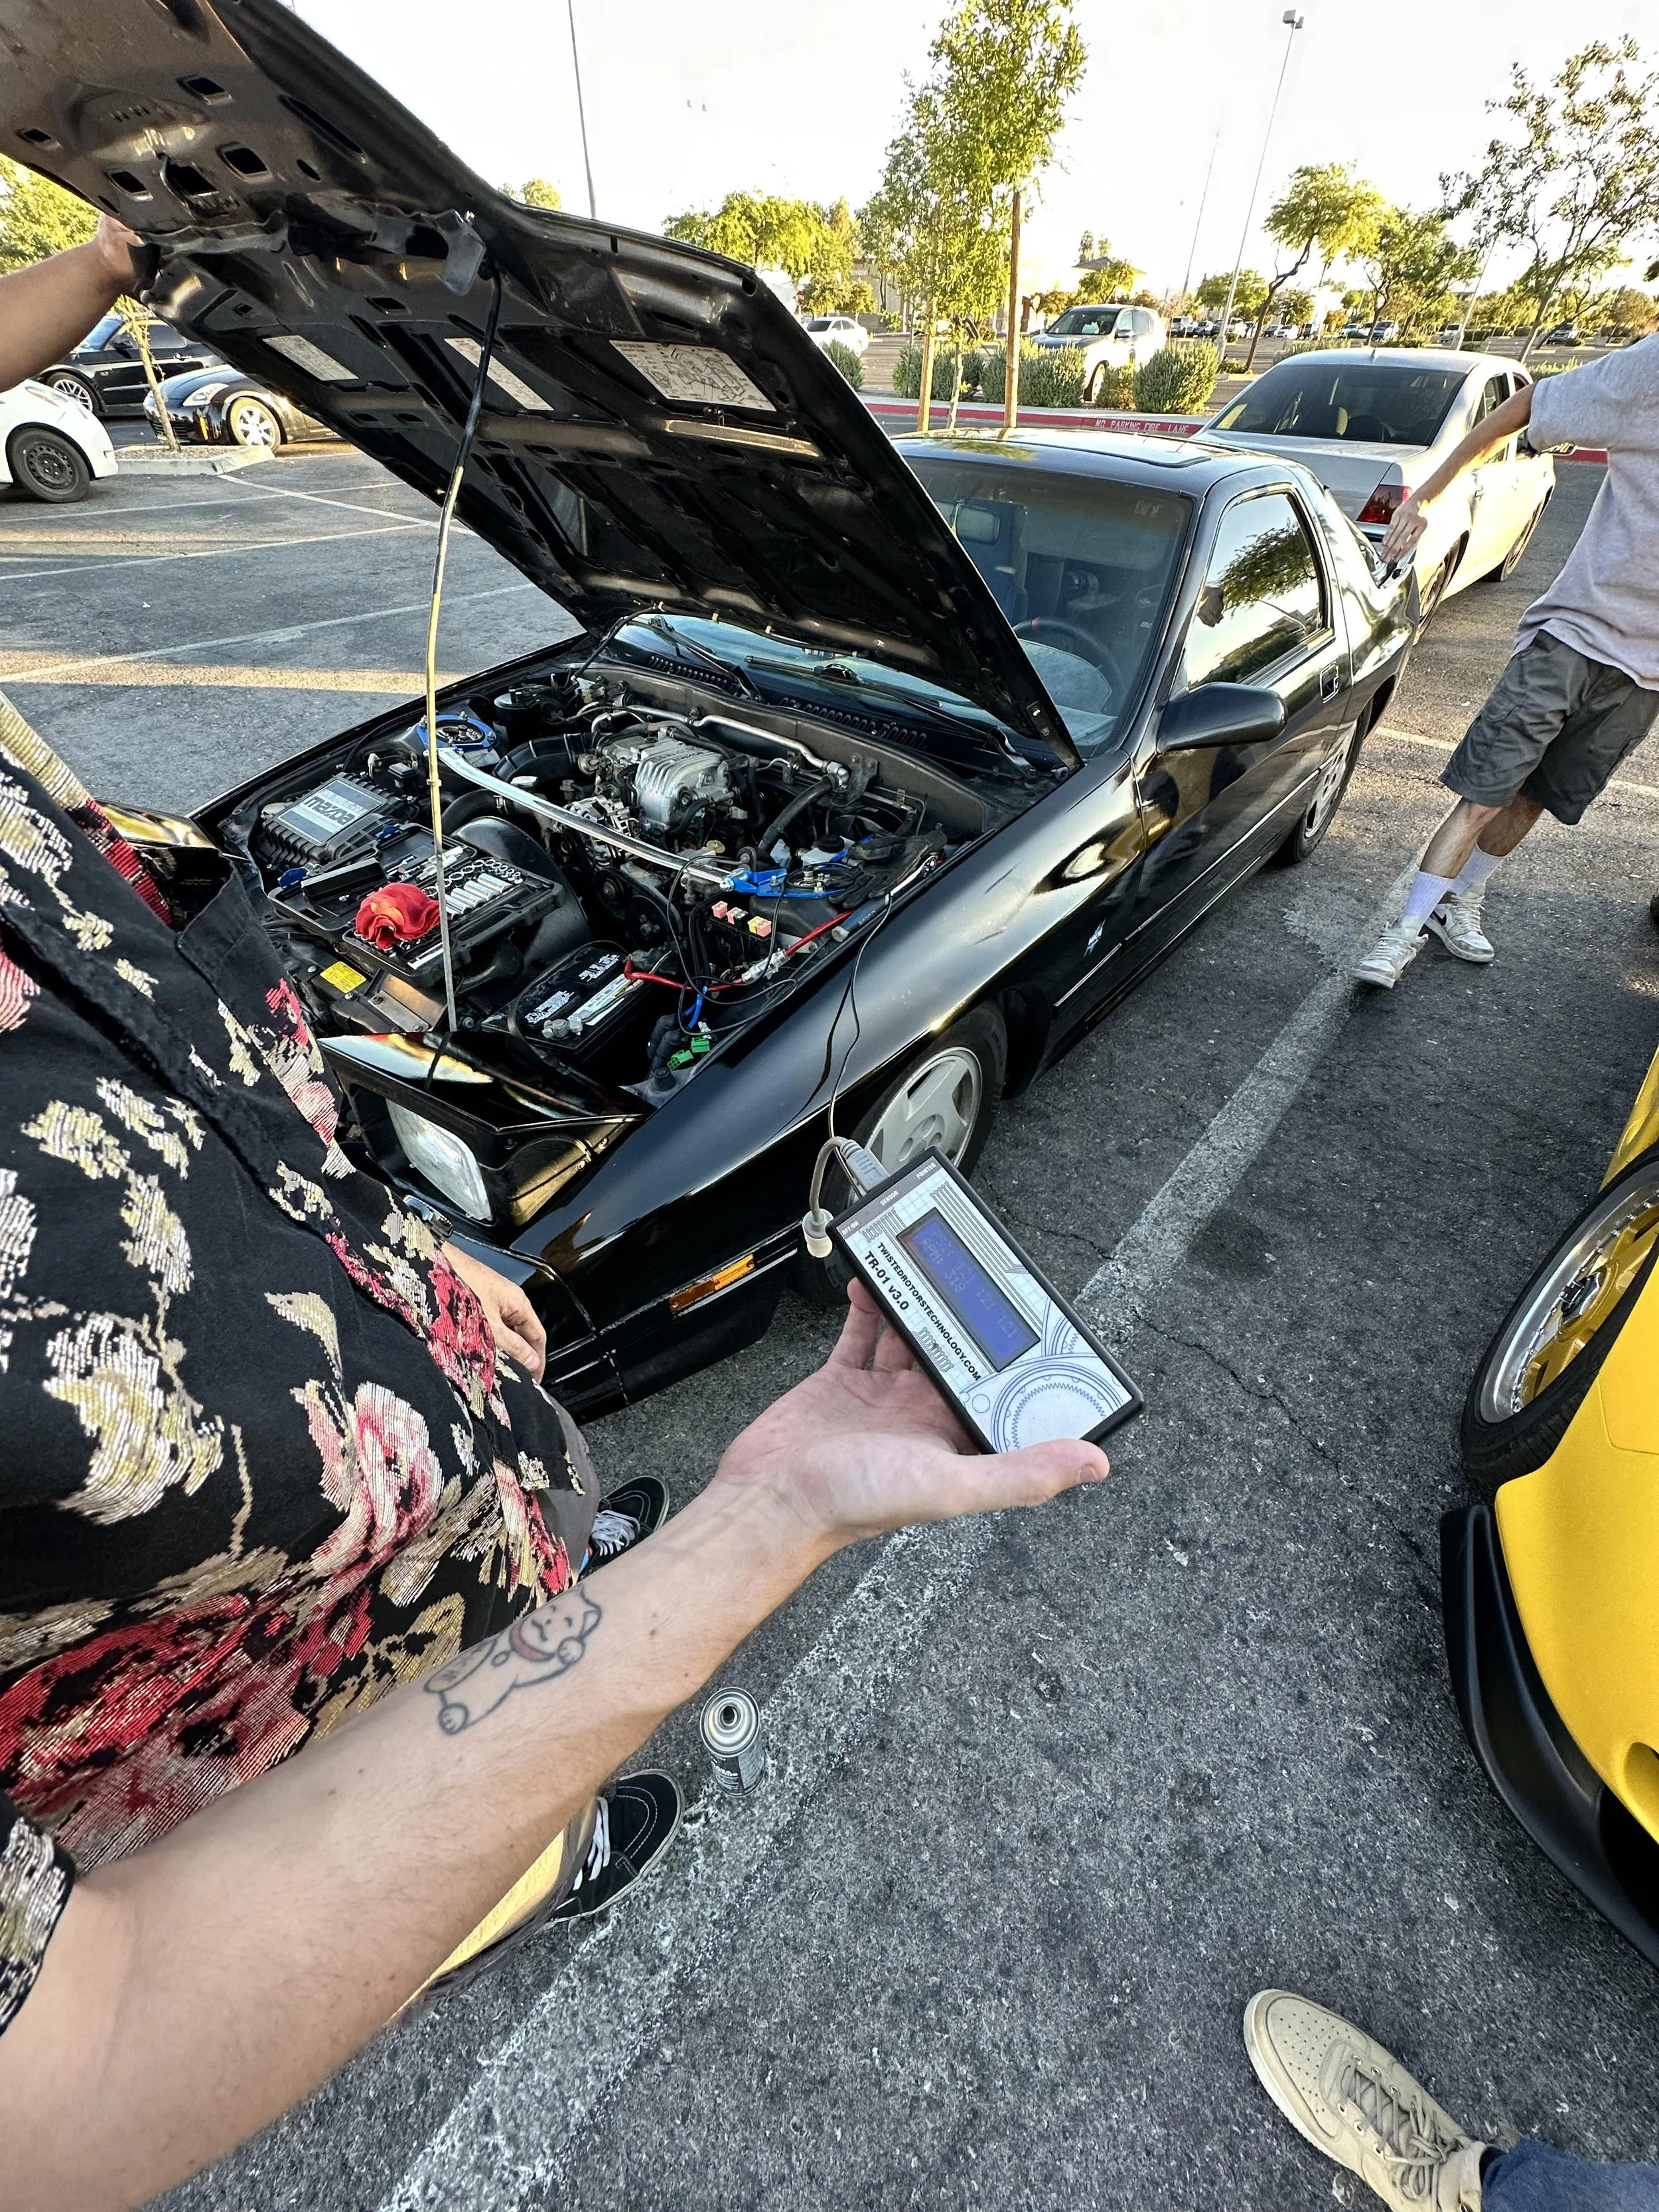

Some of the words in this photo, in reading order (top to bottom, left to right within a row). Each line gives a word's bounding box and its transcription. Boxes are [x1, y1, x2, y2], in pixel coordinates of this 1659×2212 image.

[1095, 419, 1106, 428] NO
[1110, 420, 1141, 430] PARKING
[1143, 422, 1161, 431] FIRE
[1167, 423, 1190, 433] LANE
[304, 796, 355, 825] mazda
[916, 1162, 936, 1179] PRINTER
[880, 1190, 899, 1205] SENSOR
[841, 1220, 859, 1235] OFF/ON
[863, 1251, 891, 1284] TR-01
[887, 1284, 910, 1311] v3.0
[876, 1242, 981, 1381] TWISTEDROTORSTECHNOLOGY.COM
[975, 1288, 996, 1311] 121
[997, 1315, 1017, 1338] 121
